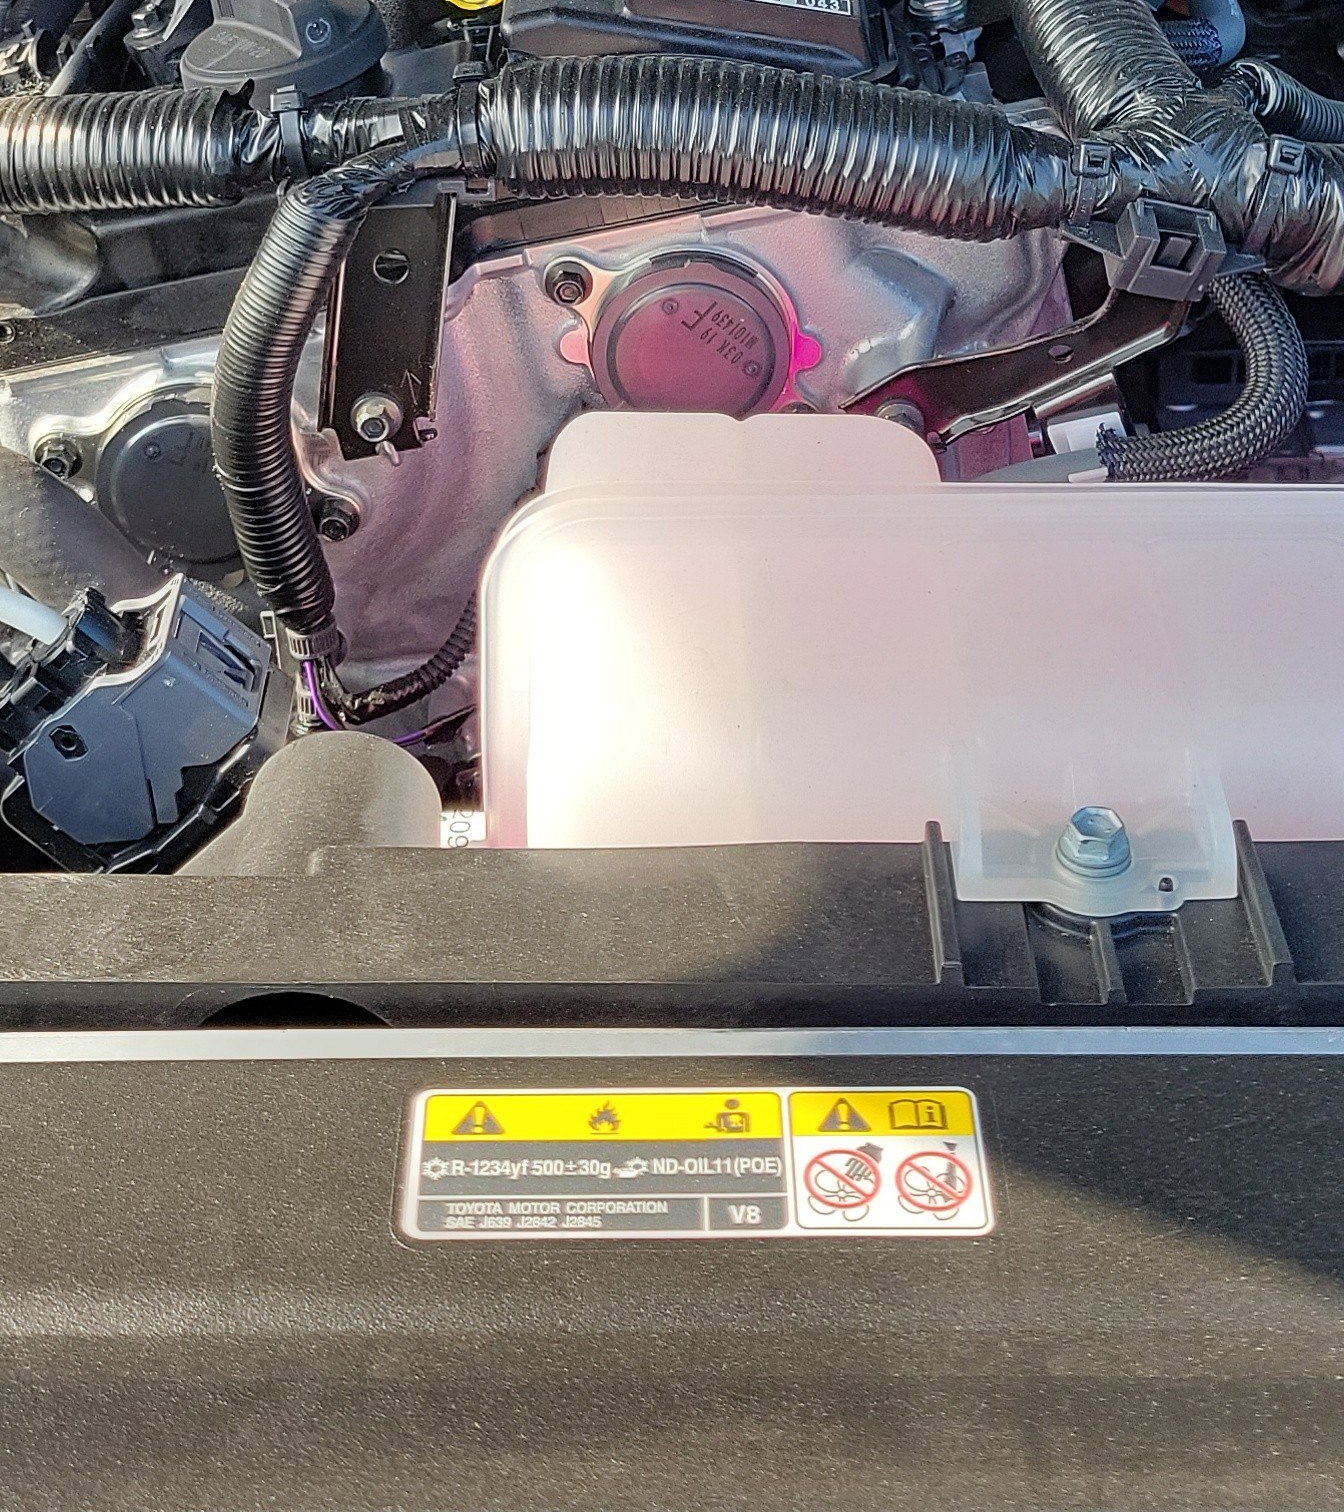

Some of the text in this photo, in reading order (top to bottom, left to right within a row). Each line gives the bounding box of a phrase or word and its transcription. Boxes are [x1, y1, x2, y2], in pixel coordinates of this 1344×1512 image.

[451, 1157, 782, 1179] R-1234yf 500±30g ND-OIL11(POE)
[446, 1201, 668, 1214] TOYOTA MOTOR CORPORATION
[728, 1205, 761, 1224] V8
[445, 1216, 475, 1228] SAE
